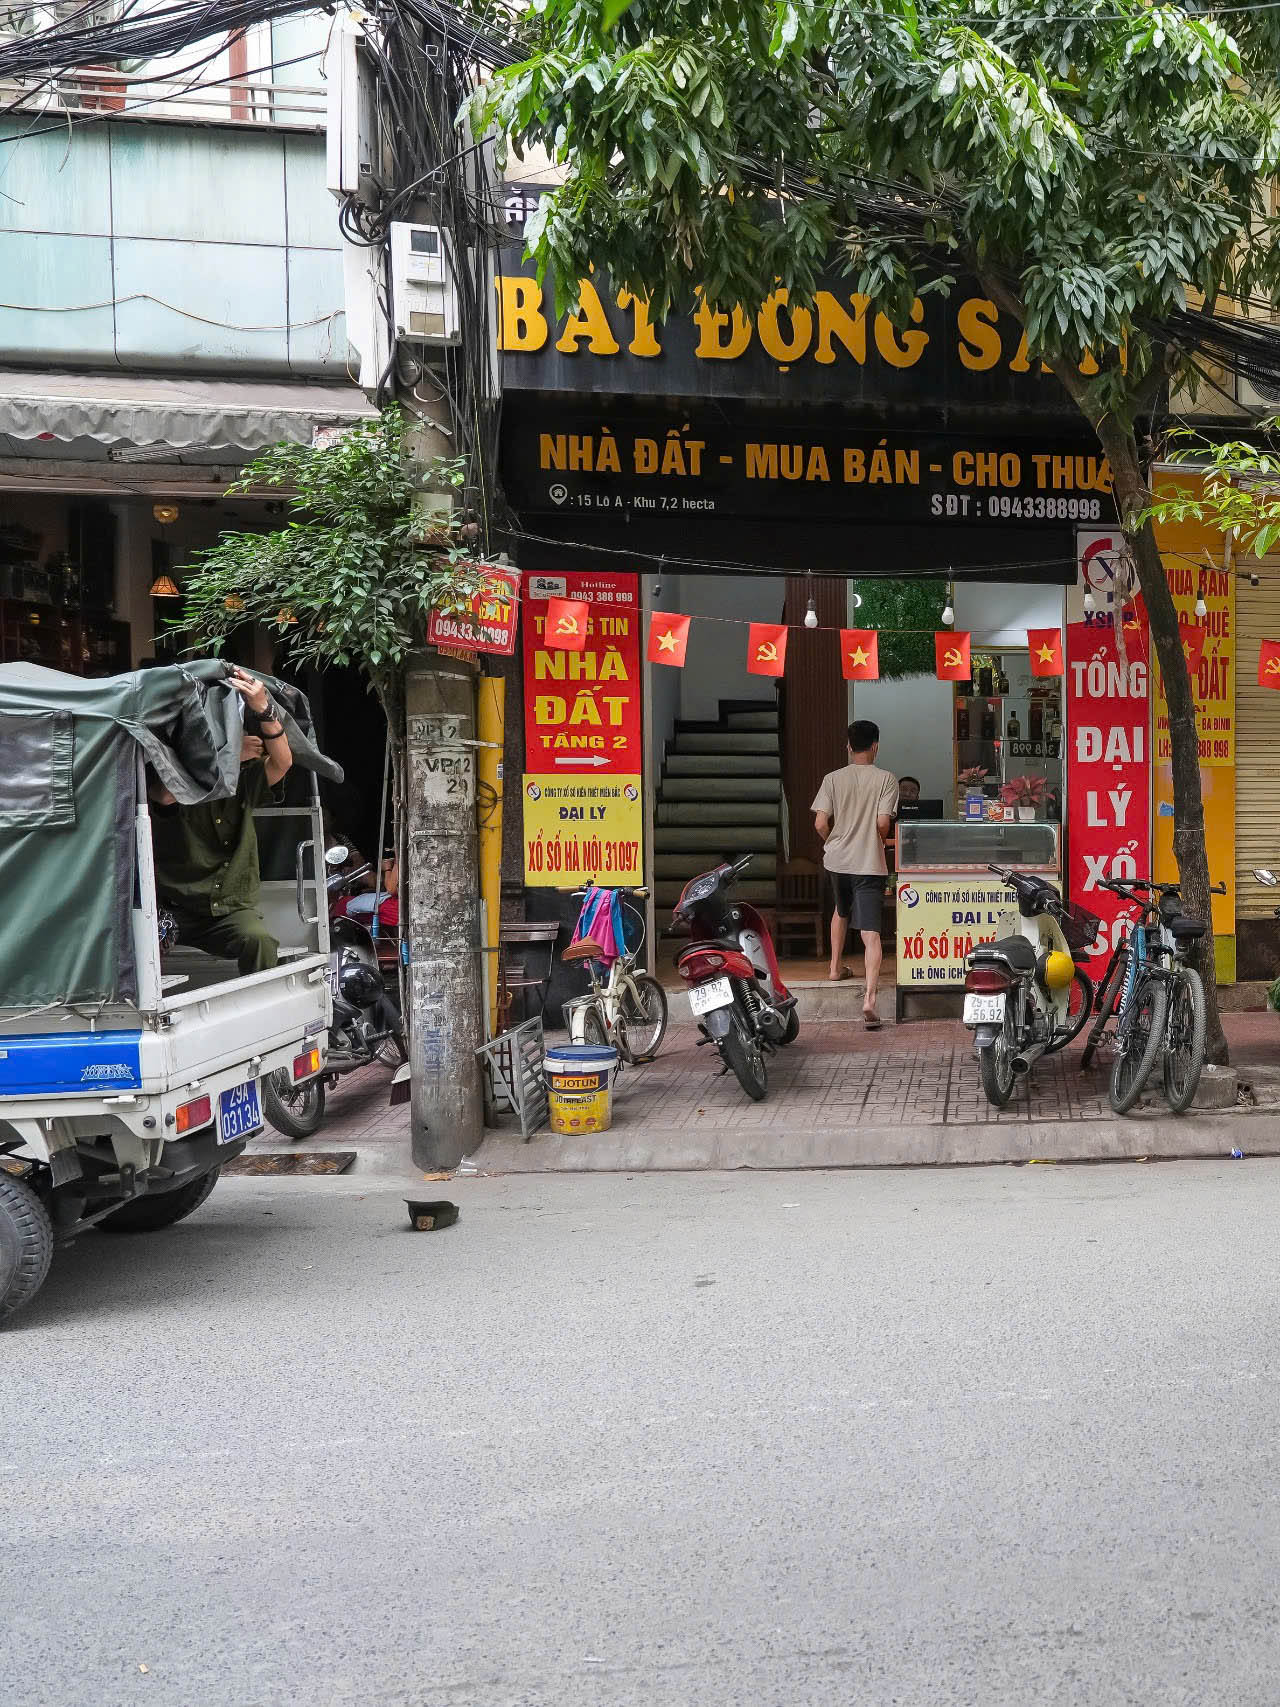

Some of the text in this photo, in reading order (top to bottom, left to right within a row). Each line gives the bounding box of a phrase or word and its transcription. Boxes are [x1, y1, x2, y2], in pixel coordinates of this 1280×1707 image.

[540, 426, 622, 473] NHÀ
[633, 424, 706, 476] ĐẤT
[745, 443, 831, 481] MUA
[843, 439, 920, 484] BÁN
[953, 451, 1021, 488] CHO
[577, 494, 592, 507] 15
[596, 494, 610, 507] Lô
[614, 495, 623, 507] A
[633, 496, 656, 508] Khu
[660, 497, 678, 511] 7,2
[682, 497, 715, 510] hecta
[931, 493, 971, 516] SĐT
[988, 496, 1101, 520] 0943388998
[581, 581, 617, 589] Hotline
[571, 591, 594, 602] 0943
[616, 592, 633, 602] 998
[600, 617, 629, 635] TIN
[534, 645, 629, 680] NHÀ
[1071, 647, 1147, 699] TỔNG
[533, 685, 630, 725] ĐẤT
[1202, 718, 1211, 730] BA
[612, 735, 628, 749] 2
[1075, 727, 1144, 770] ĐẠI
[1214, 740, 1229, 758] 998
[559, 804, 607, 821] ĐẠI LÝ
[1086, 783, 1133, 827] LÝ
[527, 827, 639, 879] XỔ SỐ HÀ NỘI 31097
[1082, 840, 1138, 892] XỔ
[925, 889, 943, 903] CÔNG
[944, 891, 951, 903] TY
[951, 911, 982, 927] ĐẠI
[903, 927, 925, 960] XỔ
[928, 928, 950, 960] SỐ
[911, 964, 963, 980] LH: ÔNG ÍCH
[967, 1008, 1002, 1021] 56.92
[562, 1077, 597, 1088] JOTUN
[223, 1101, 260, 1138] 031.34
